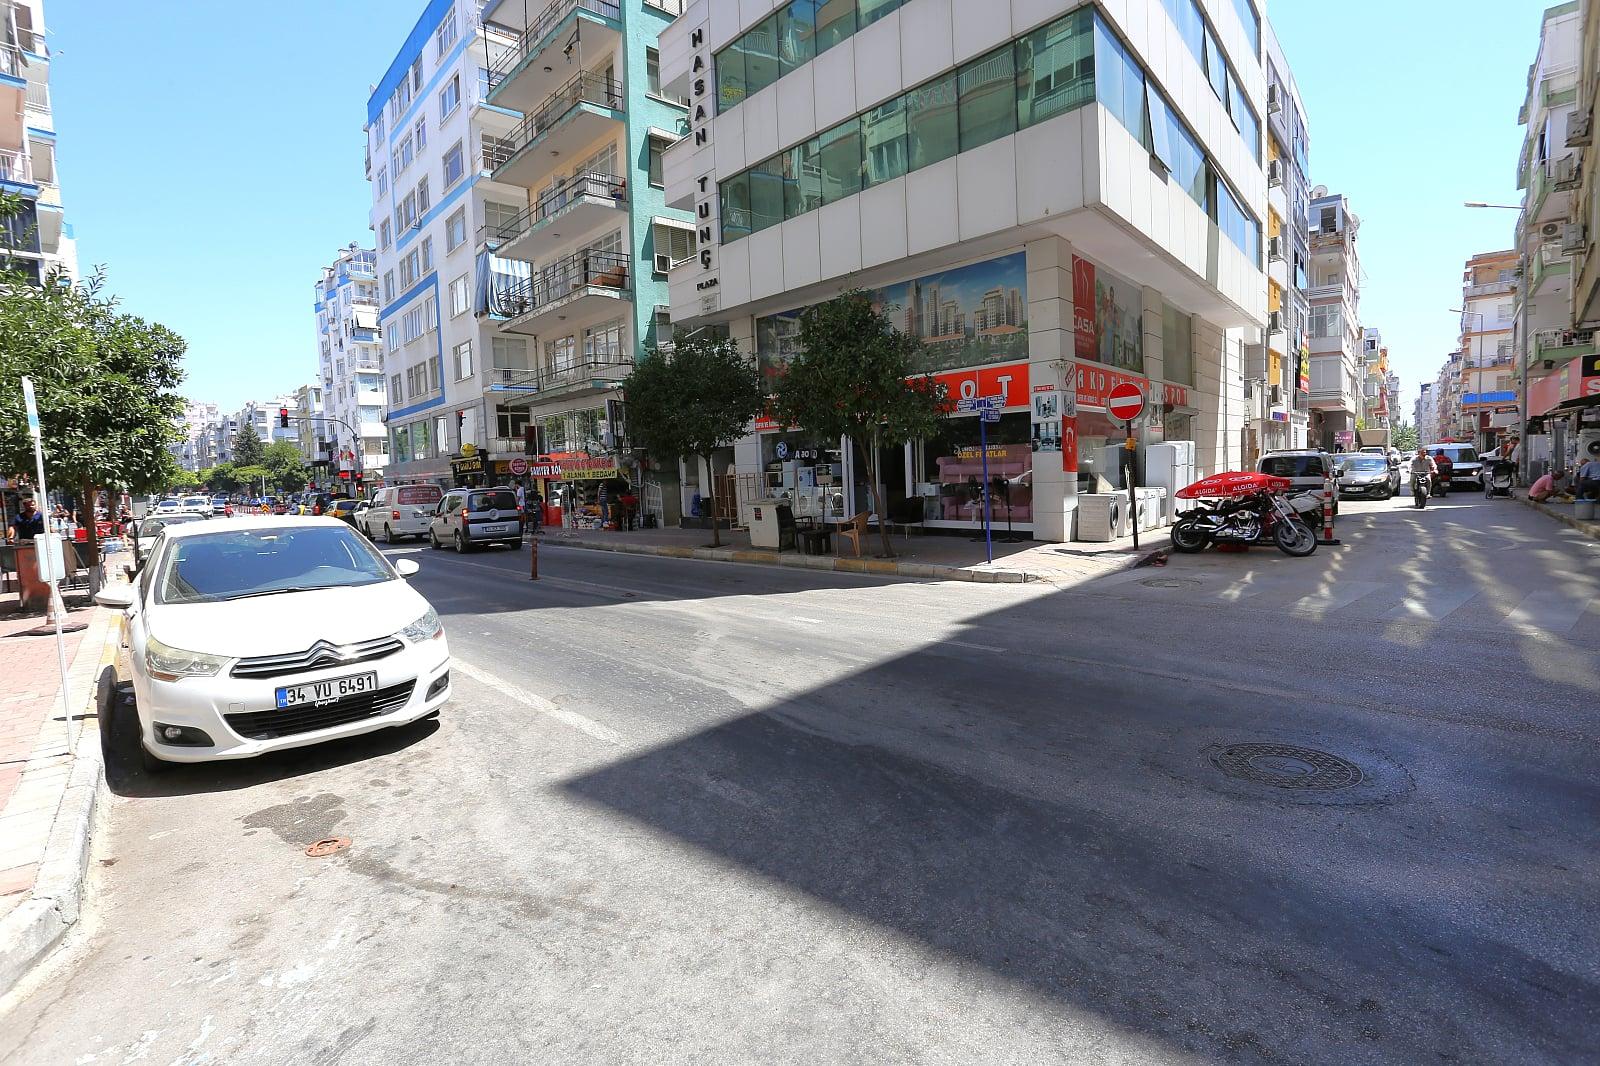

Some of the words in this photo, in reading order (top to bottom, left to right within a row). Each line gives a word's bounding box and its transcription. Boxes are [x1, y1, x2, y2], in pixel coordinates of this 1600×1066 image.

[691, 28, 706, 146] HASAN
[697, 176, 711, 270] TUNÇ
[696, 277, 718, 291] PLAZA
[975, 449, 1007, 459] FİATLAR
[1232, 482, 1258, 491] ALGIDA
[287, 687, 306, 703] 34
[313, 682, 332, 699] VU
[338, 675, 373, 694] 6491
